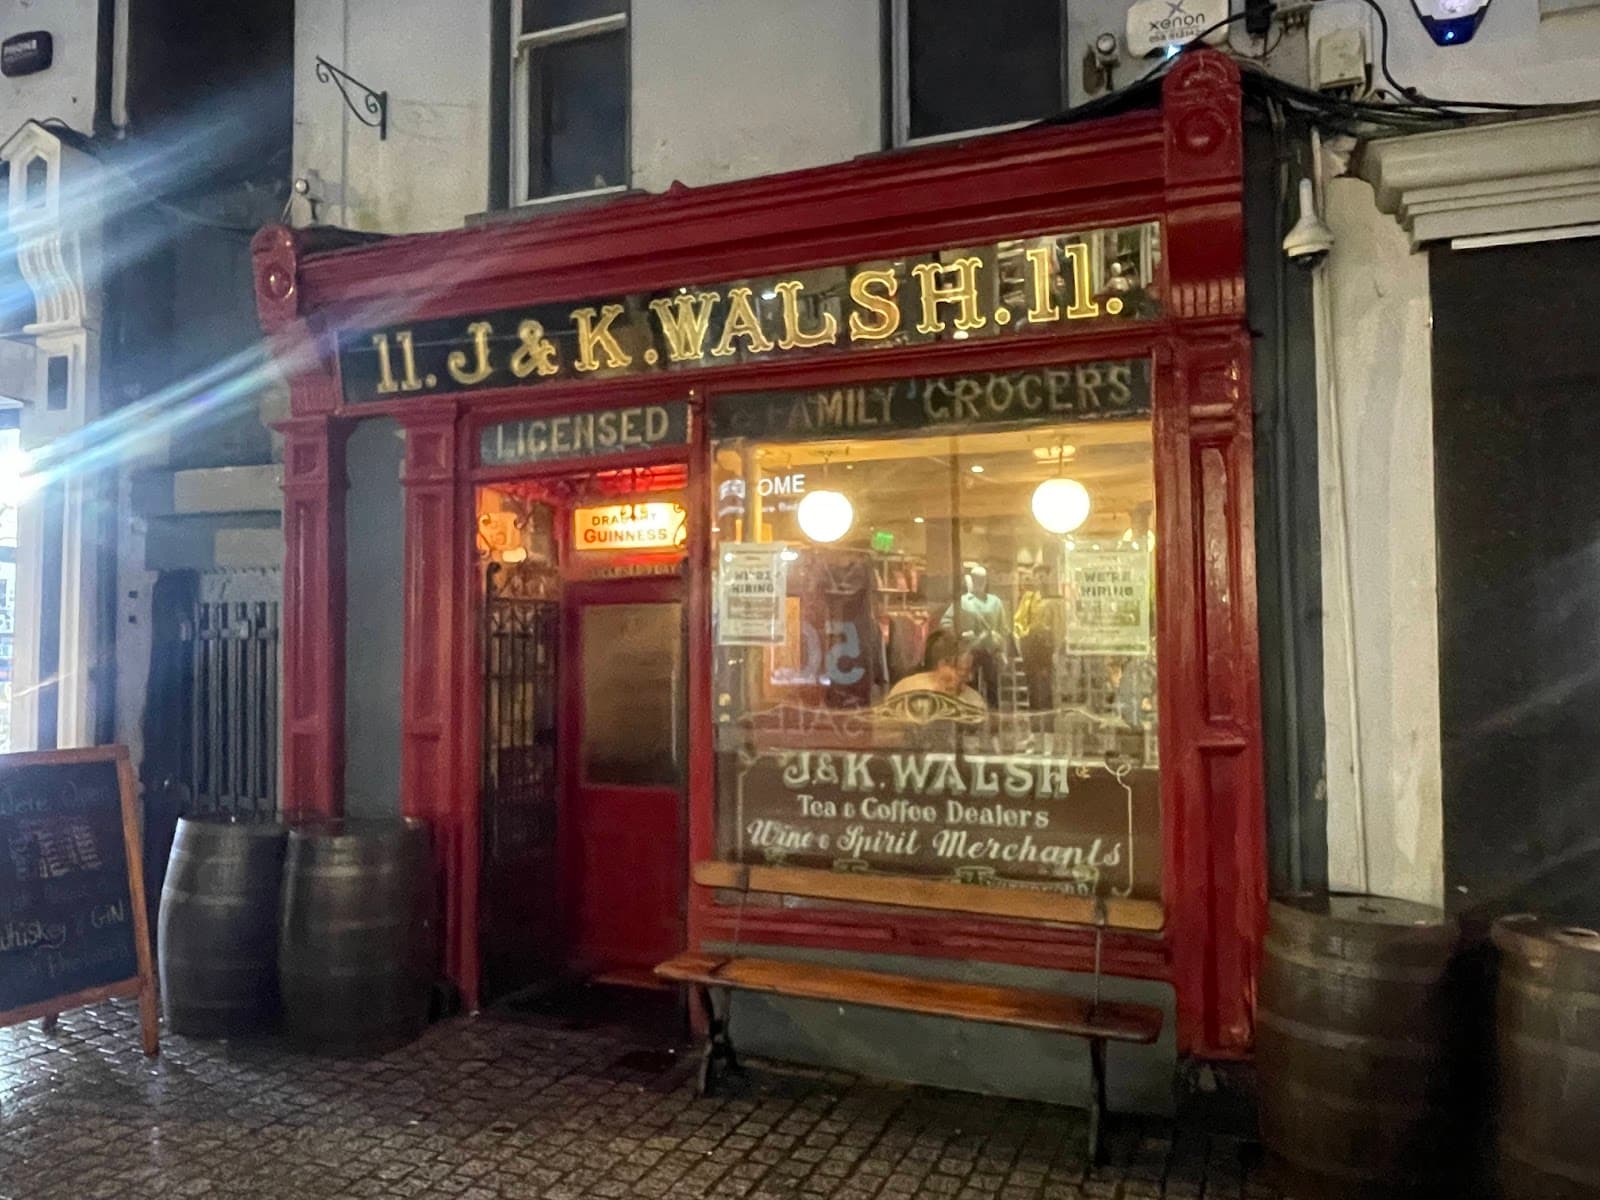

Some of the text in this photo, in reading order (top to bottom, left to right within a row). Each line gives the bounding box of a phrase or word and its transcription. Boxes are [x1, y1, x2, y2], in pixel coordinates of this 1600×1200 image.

[1149, 12, 1206, 31] xenon
[510, 319, 560, 378] &
[766, 385, 895, 432] FAMILY
[922, 365, 1131, 420] GROCERS
[496, 405, 669, 459] LICENSED
[584, 528, 669, 543] GUINNESS
[890, 753, 1071, 797] WALSH
[797, 793, 837, 818] Tea
[860, 796, 937, 823] Coffee
[946, 799, 1050, 829] Dealers
[746, 819, 815, 850] Wine
[836, 823, 921, 859] Spirit
[931, 828, 1122, 867] Merchants
